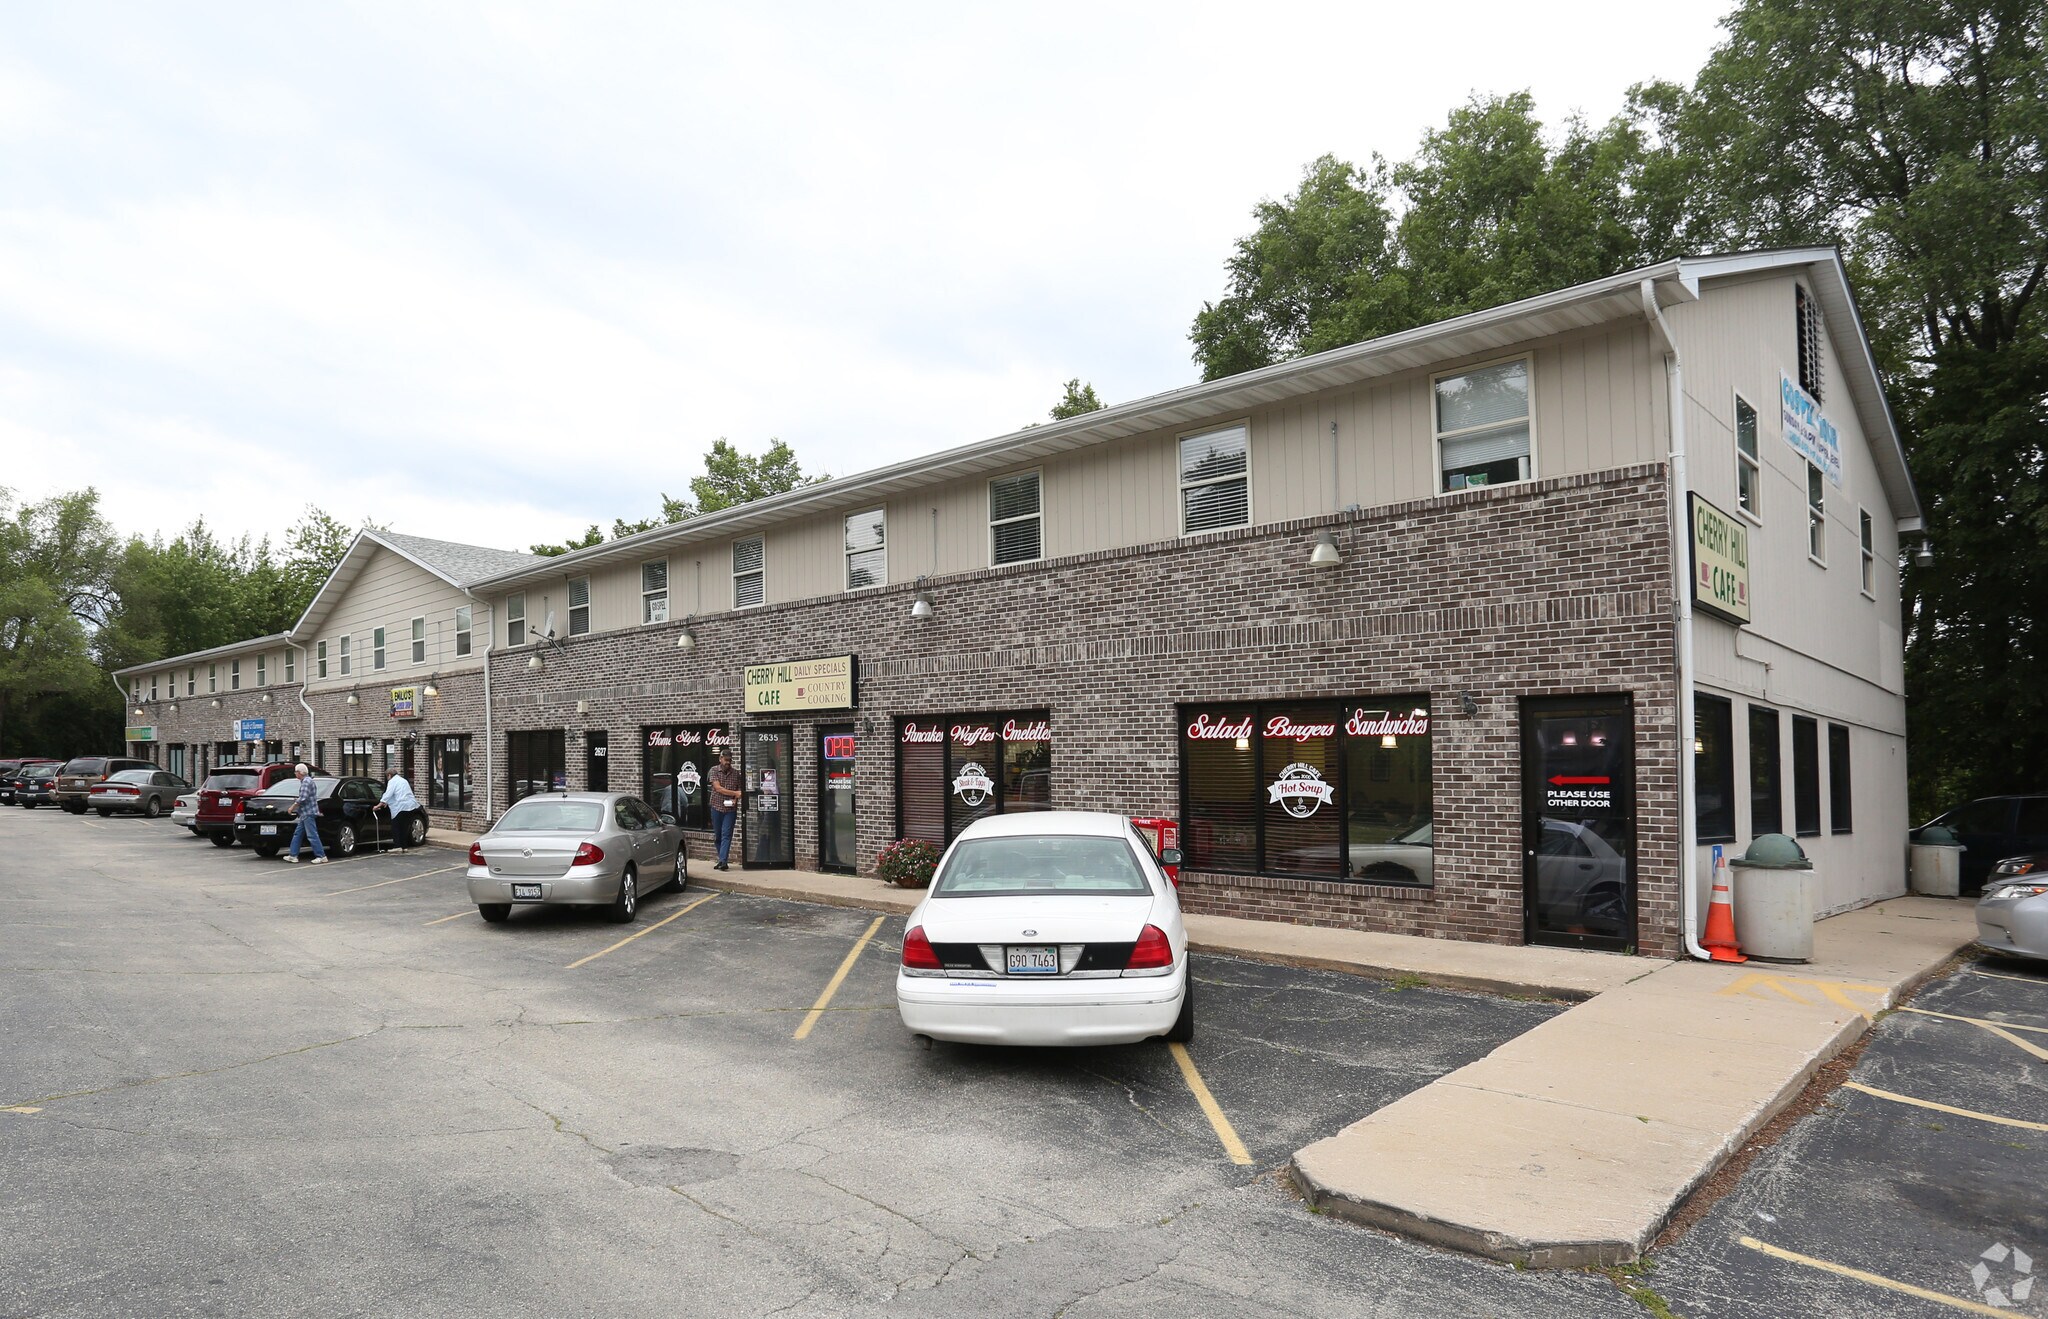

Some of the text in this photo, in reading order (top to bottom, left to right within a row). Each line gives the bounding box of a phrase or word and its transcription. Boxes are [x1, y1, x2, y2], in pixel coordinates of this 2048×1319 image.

[1697, 505, 1746, 569] CHERRY HILL
[1713, 566, 1736, 606] CAFE
[747, 665, 792, 685] CHERRY HILL
[794, 662, 846, 677] DAILY SPECIALS
[807, 681, 847, 693] COUNTRY
[758, 690, 780, 706] CAFE
[807, 693, 846, 704] COOKING
[902, 719, 1051, 746] Pancakes Waffles Omelettes
[1187, 707, 1429, 743] Salads Burgers Sandwiches
[675, 729, 701, 746] Style
[758, 734, 779, 742] 2635
[1279, 762, 1297, 779] CHERRY
[1308, 765, 1322, 779] CAFE
[1278, 781, 1323, 796] Hot Soup
[1547, 790, 1611, 799] PLEASE USE
[1547, 799, 1611, 808] OTHER DOOR
[1009, 954, 1055, 968] G90 7463
